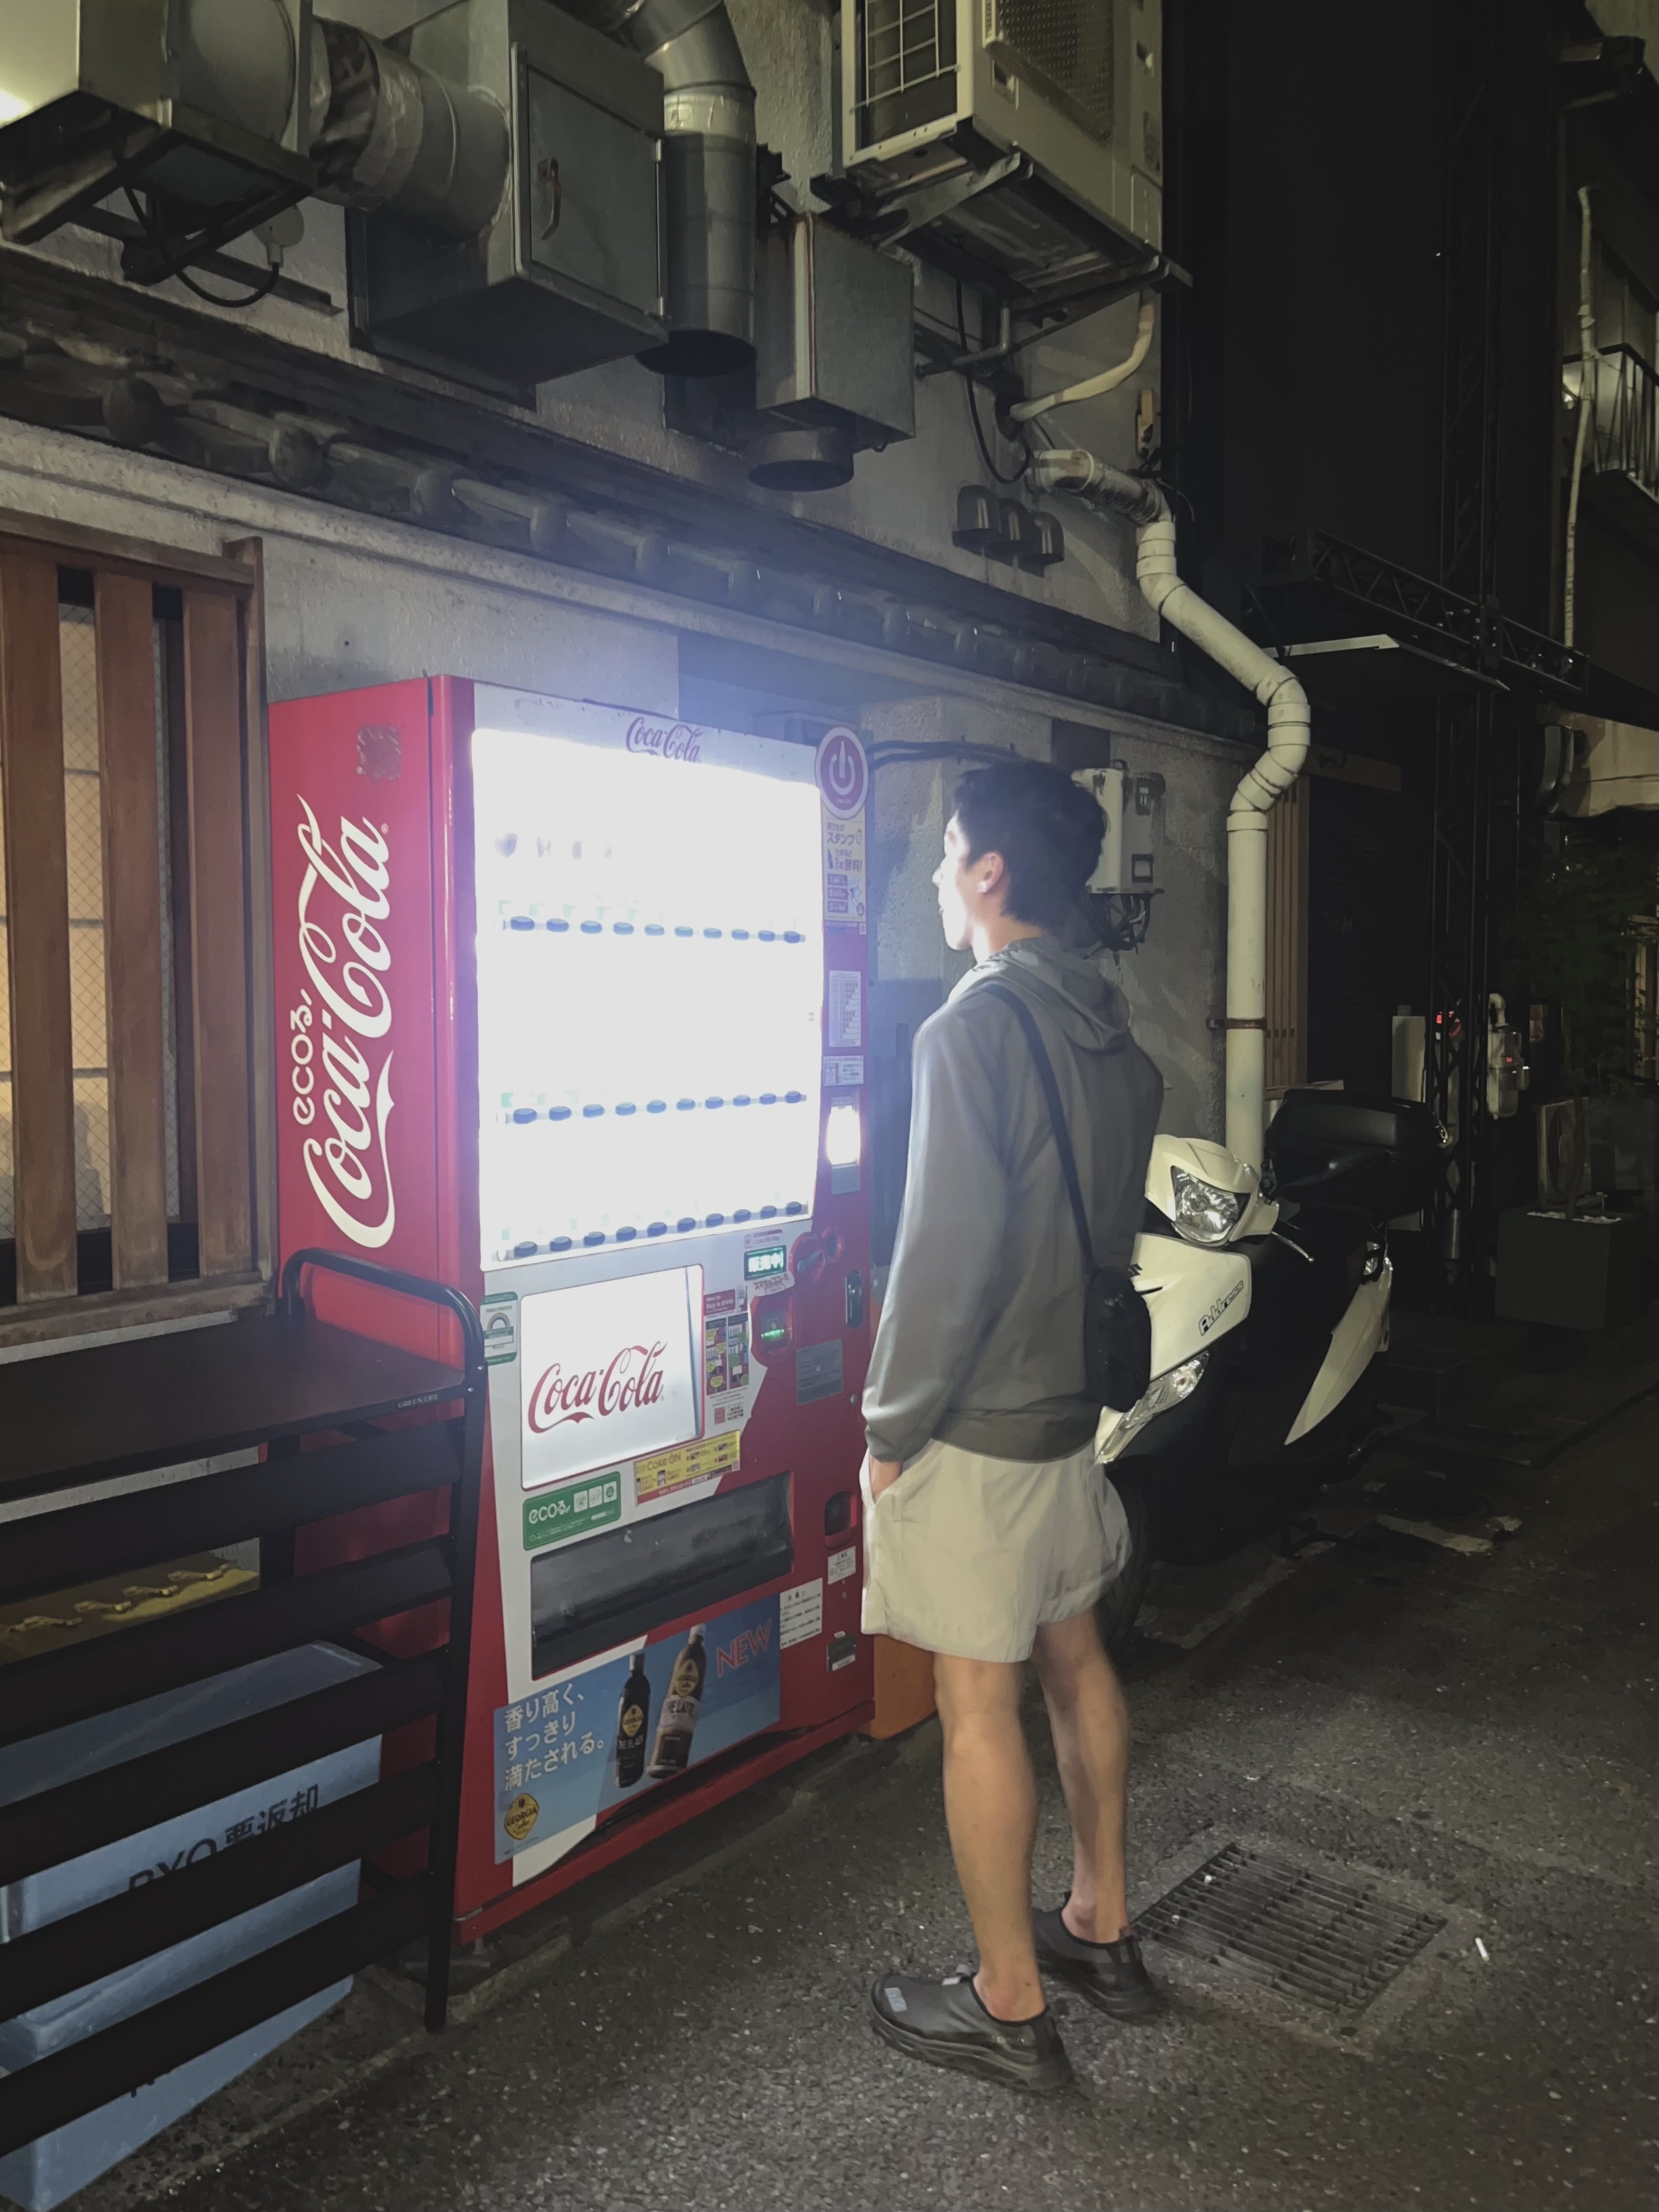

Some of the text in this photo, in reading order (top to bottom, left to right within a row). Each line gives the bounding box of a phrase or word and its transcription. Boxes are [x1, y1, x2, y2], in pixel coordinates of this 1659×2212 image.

[626, 717, 702, 763] Coca-Cola
[297, 793, 395, 1249] Coca-Cola
[1199, 1280, 1244, 1336] Address
[528, 1341, 668, 1433] Coca-Cola
[646, 1456, 667, 1471] Coke
[716, 1617, 772, 1678] NEW
[504, 1682, 584, 1733] 香り高く、
[504, 1710, 576, 1762] すっきり
[504, 1731, 605, 1792] 満たされる。
